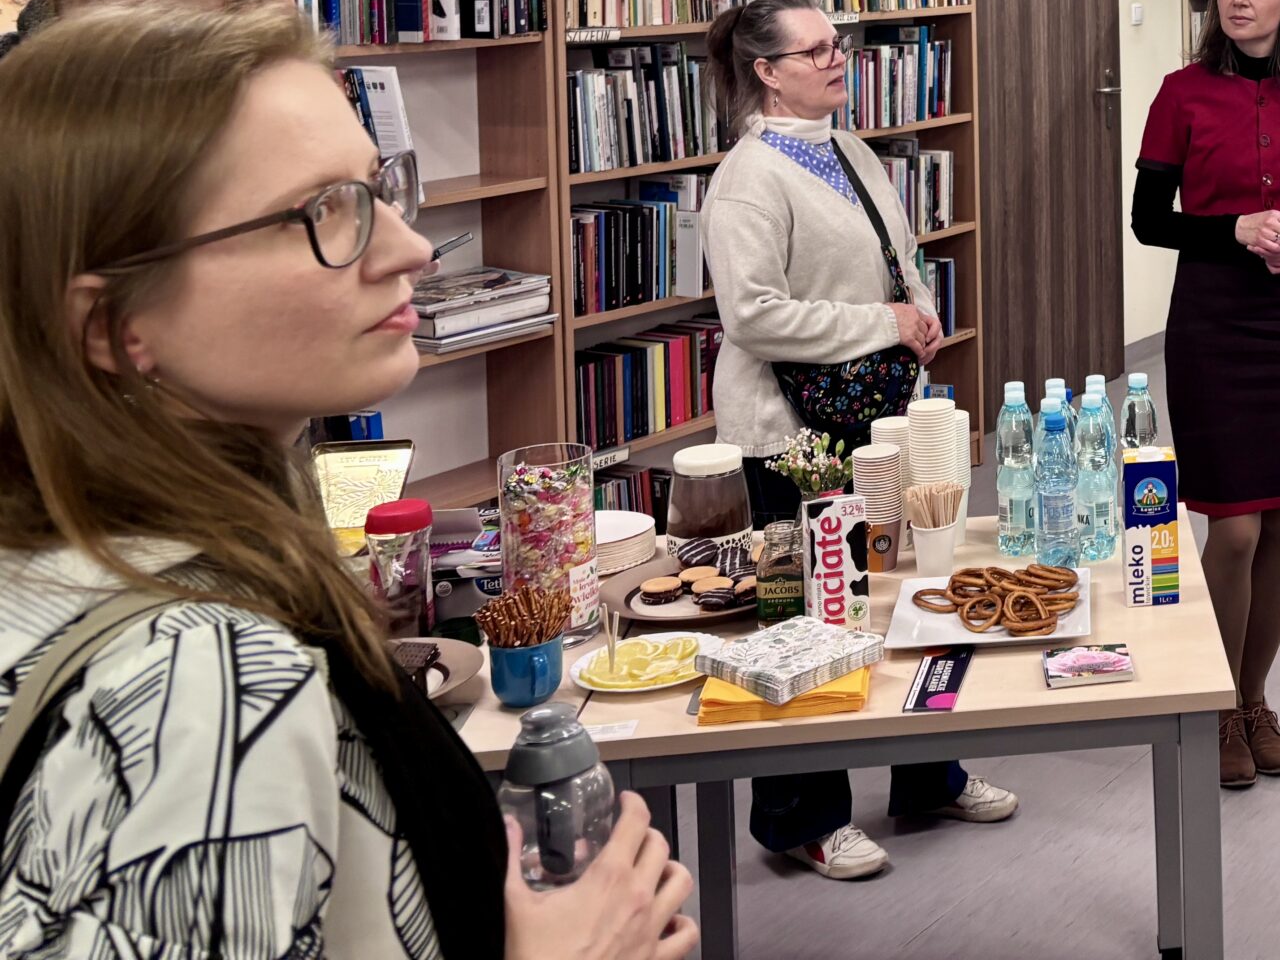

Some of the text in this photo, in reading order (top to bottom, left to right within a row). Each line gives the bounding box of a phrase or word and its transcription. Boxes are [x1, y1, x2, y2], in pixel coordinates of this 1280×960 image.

[566, 29, 610, 41] SZCZECIN
[1128, 544, 1145, 604] mleko
[763, 585, 800, 596] JACOBS
